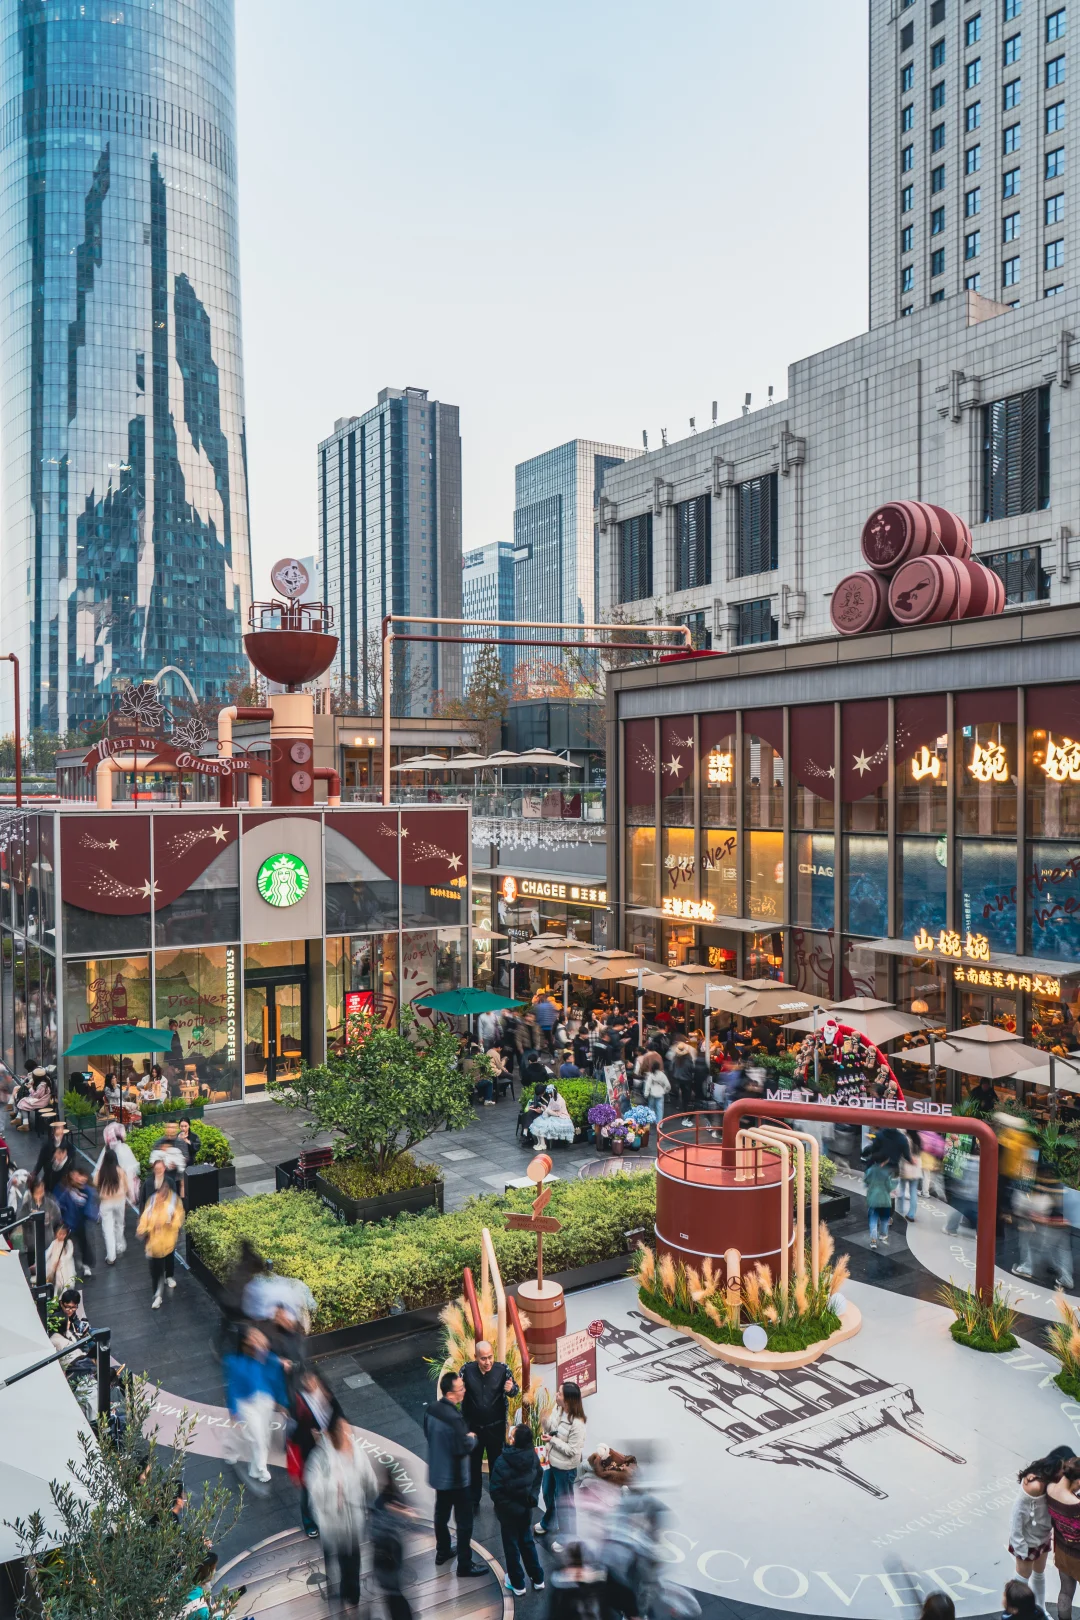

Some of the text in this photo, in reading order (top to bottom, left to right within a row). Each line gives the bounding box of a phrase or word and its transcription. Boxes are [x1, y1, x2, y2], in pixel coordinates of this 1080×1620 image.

[139, 738, 158, 750] MY
[521, 880, 566, 898] CHAGEE
[914, 927, 990, 961] 山婉婉
[954, 966, 1060, 997] 云南酸菜牛肉火锅
[226, 949, 236, 1062] STARBUCKS COFFEE
[766, 1088, 953, 1116] MEET MY OTHER SIDE
[950, 1245, 977, 1271] ORLD
